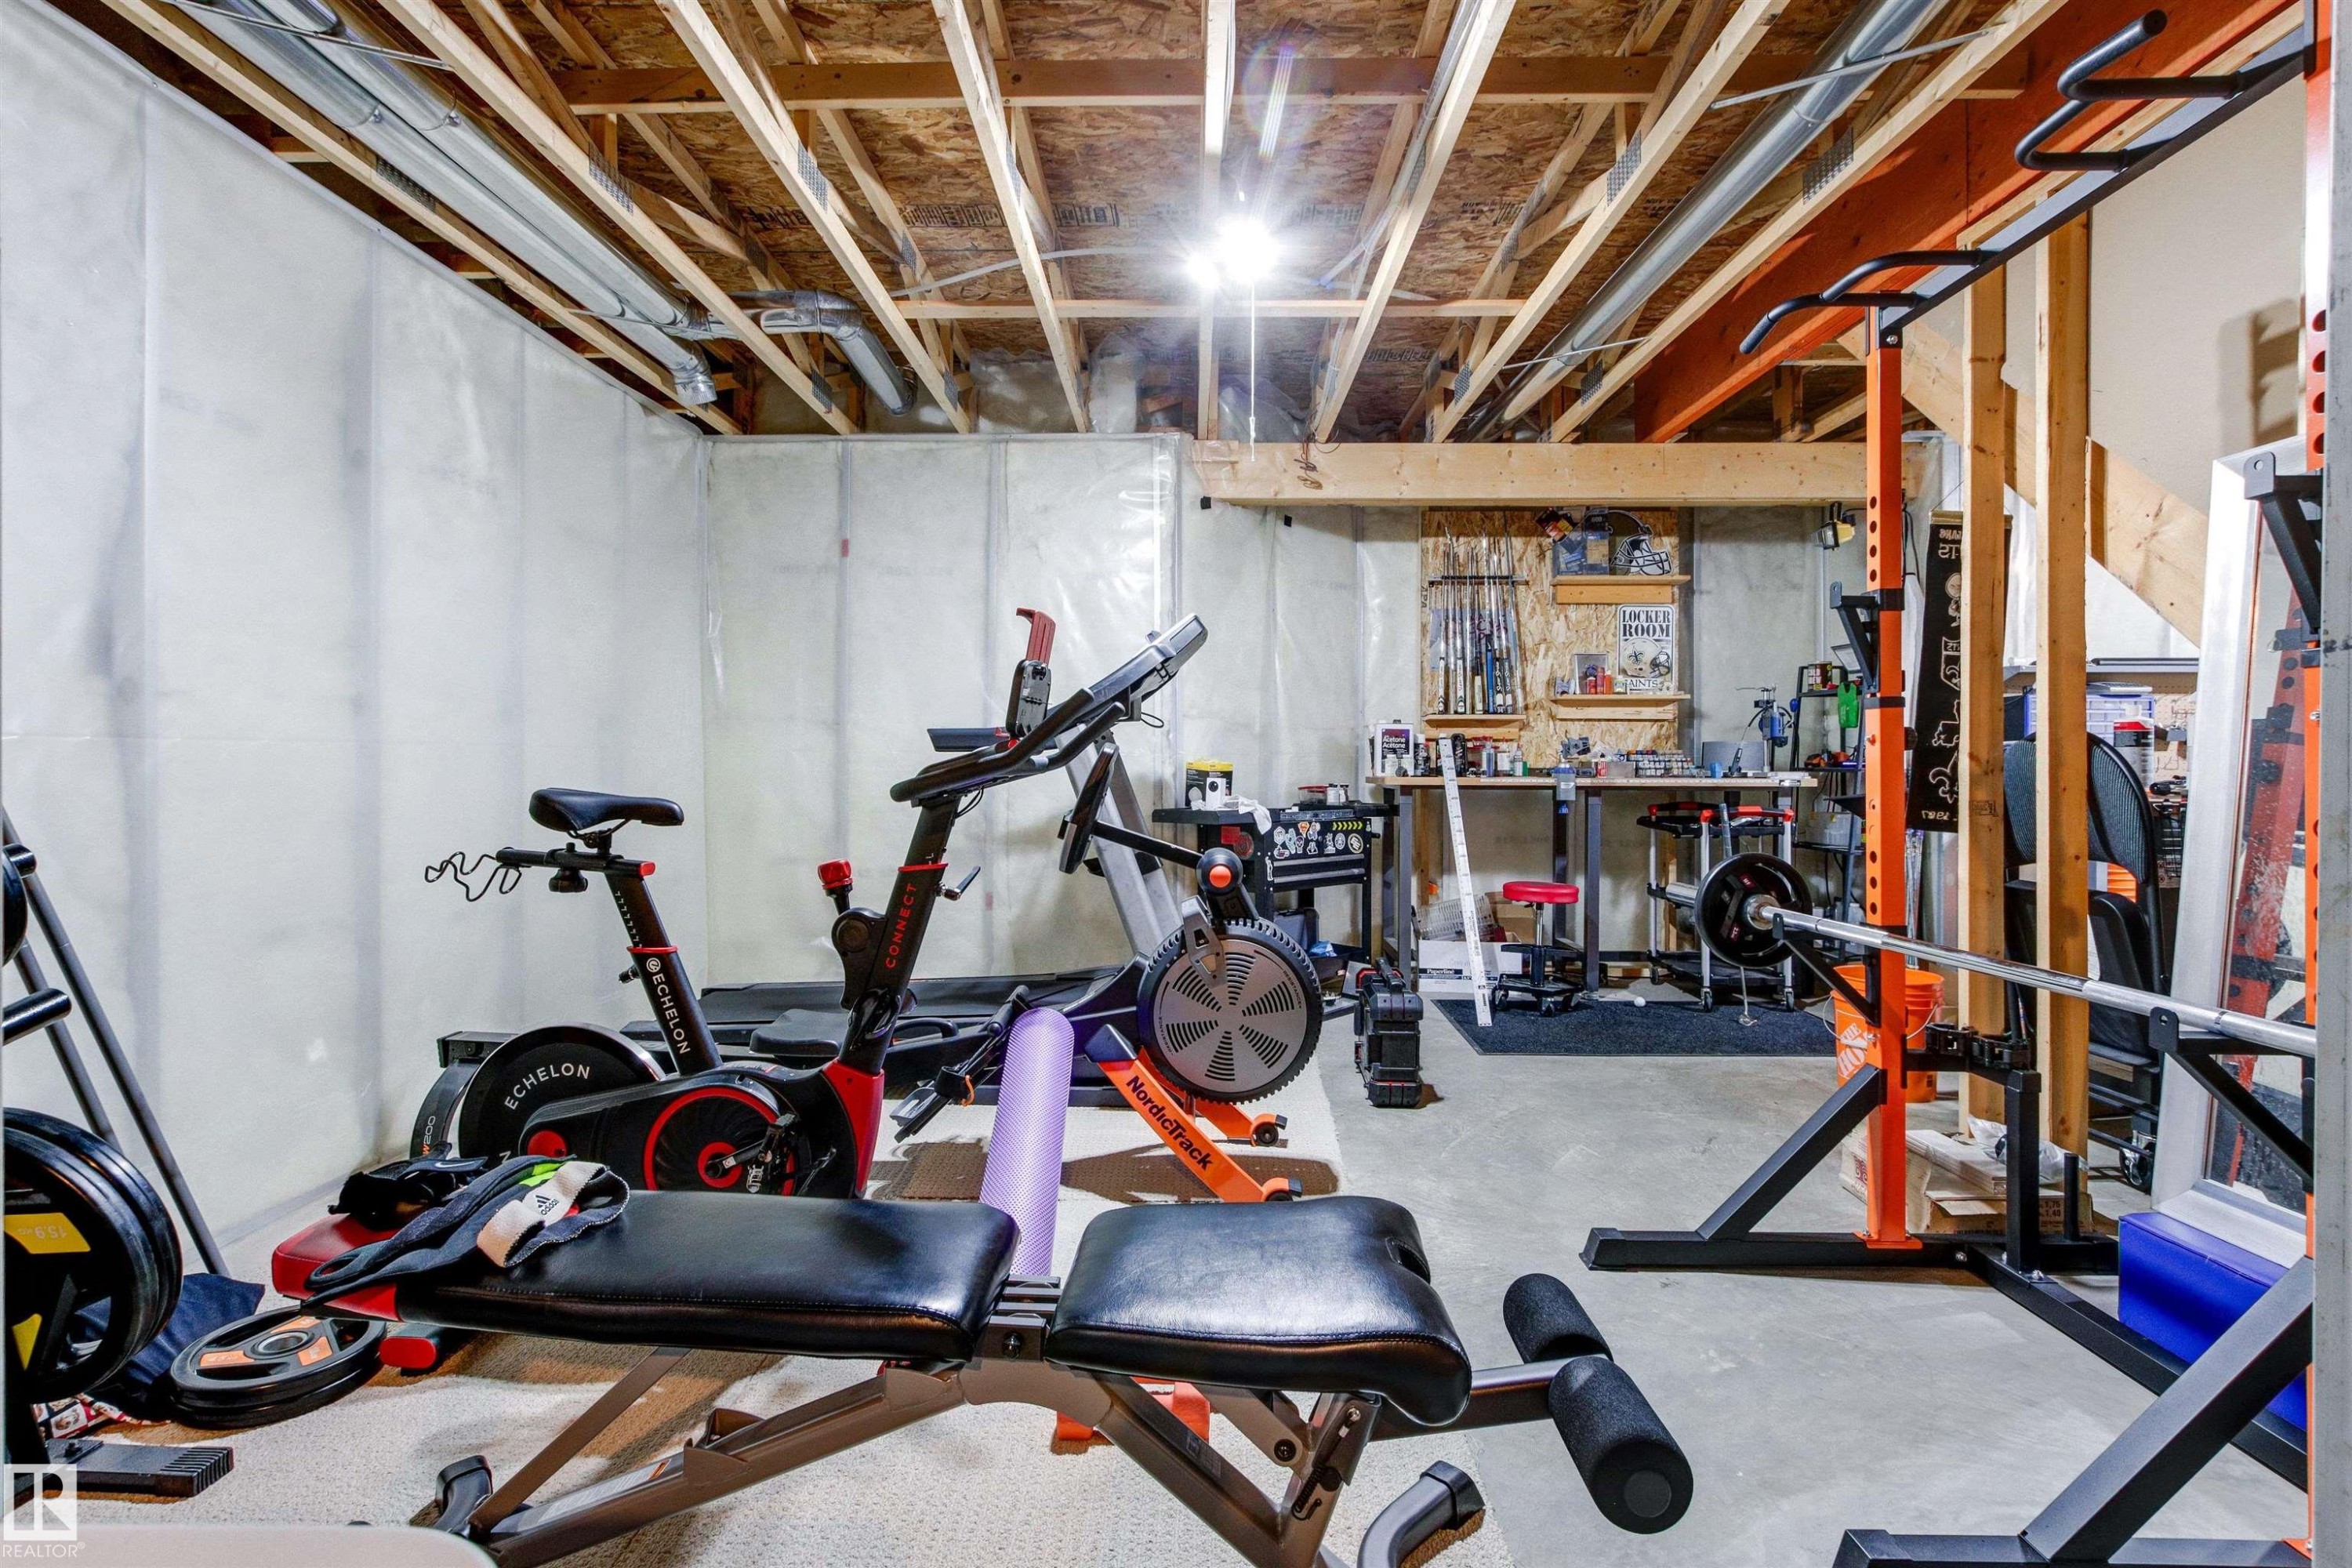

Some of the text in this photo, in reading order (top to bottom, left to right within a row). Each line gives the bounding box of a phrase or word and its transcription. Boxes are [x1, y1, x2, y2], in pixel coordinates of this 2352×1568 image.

[1621, 609, 1671, 623] LOCKER
[1621, 623, 1671, 637] ROOM
[885, 883, 916, 969] CONNECT
[652, 973, 691, 1054] ECHELON
[504, 1063, 590, 1110] ECHELON
[423, 1116, 436, 1156] W200
[1126, 1075, 1214, 1171] NordicTrack
[540, 1198, 560, 1216] adidas
